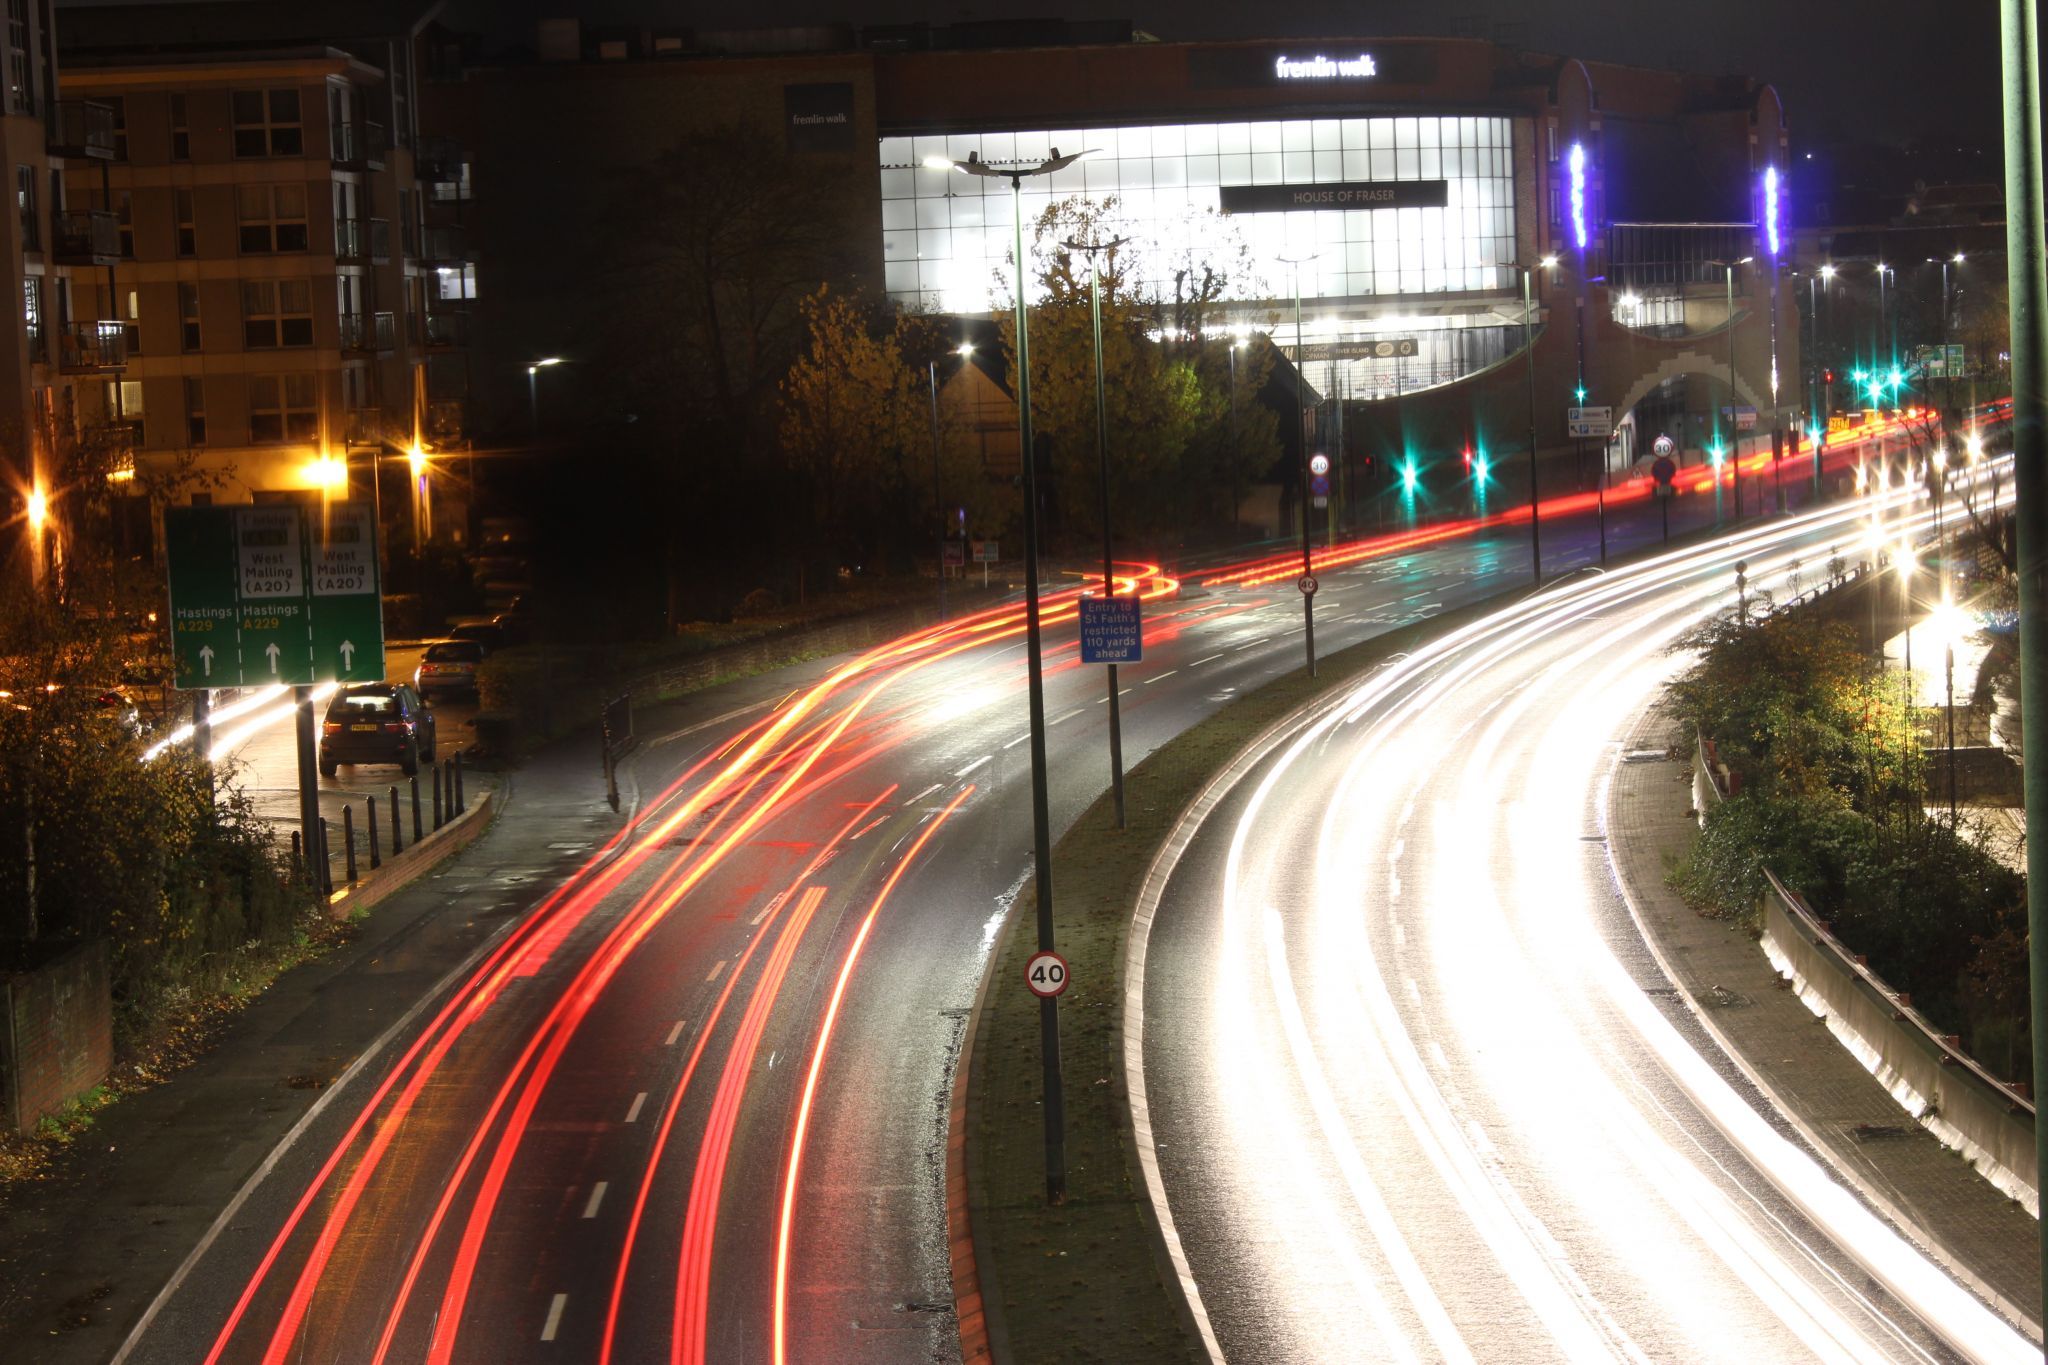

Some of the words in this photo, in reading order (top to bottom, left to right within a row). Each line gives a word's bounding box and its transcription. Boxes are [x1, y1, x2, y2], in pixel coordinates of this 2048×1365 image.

[1276, 55, 1337, 78] fremlin
[1338, 54, 1376, 76] walk
[793, 114, 825, 125] fremlin
[825, 113, 847, 124] walk
[1294, 191, 1335, 204] HOUSE
[1337, 190, 1353, 202] OF
[1356, 190, 1395, 202] FRASER
[1657, 445, 1669, 453] 30
[1313, 462, 1326, 470] 30
[252, 553, 285, 564] West
[324, 551, 356, 562] West
[245, 566, 293, 579] Malling
[317, 563, 365, 576] Malling
[245, 581, 291, 594] (A20)
[318, 578, 363, 591] (A20)
[177, 606, 233, 619] Hastings
[243, 604, 299, 617] Hastings
[1088, 603, 1116, 613] Entry
[1121, 603, 1132, 611] to
[1085, 614, 1097, 624] St
[1102, 614, 1136, 623] Faith's
[1084, 625, 1136, 635] restricted
[1087, 637, 1103, 647] 110
[1106, 637, 1136, 648] yards
[1095, 649, 1127, 658] ahead
[1031, 965, 1064, 983] 40
